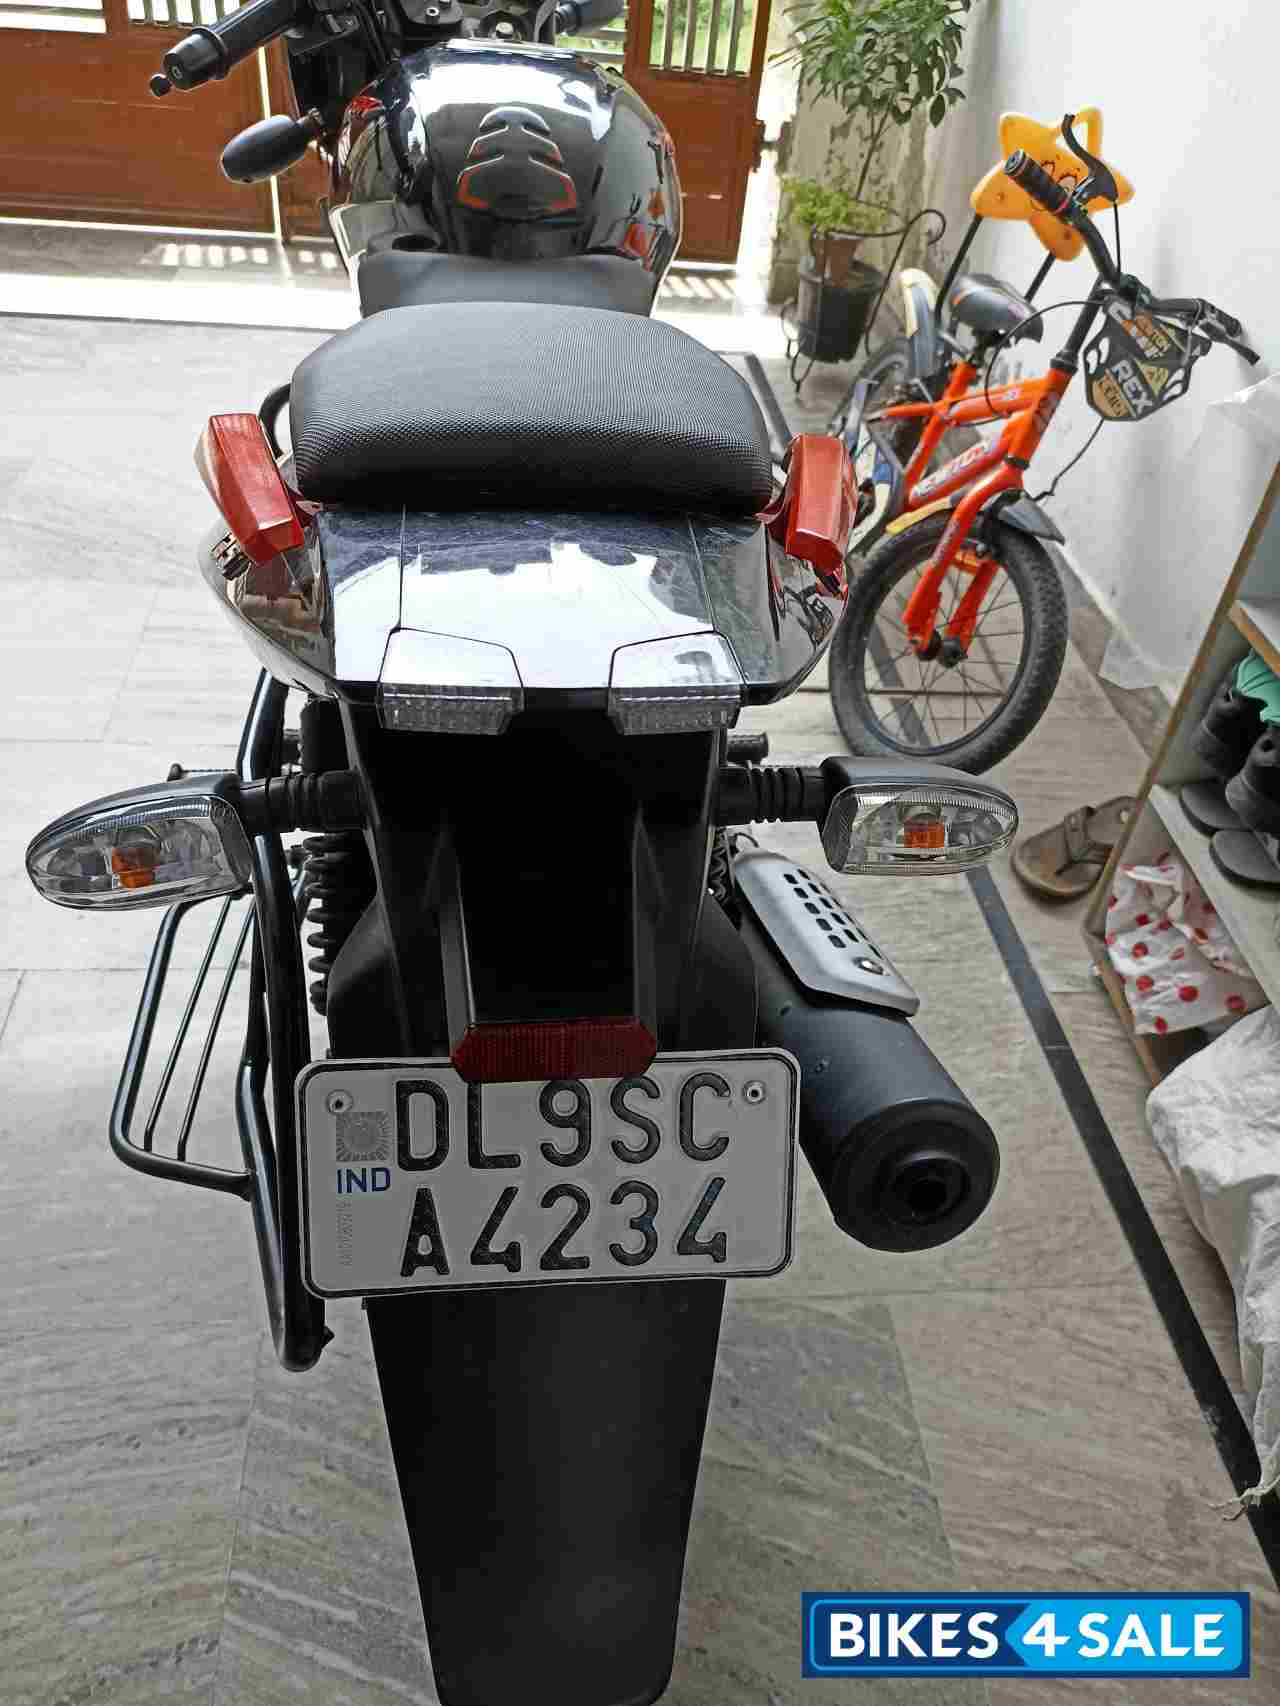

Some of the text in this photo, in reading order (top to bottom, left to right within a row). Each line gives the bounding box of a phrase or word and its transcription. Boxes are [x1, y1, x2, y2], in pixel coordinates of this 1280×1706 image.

[1110, 359, 1153, 415] REX
[395, 1071, 731, 1172] DL9SC
[336, 1167, 391, 1194] IND
[400, 1177, 727, 1276] A4234
